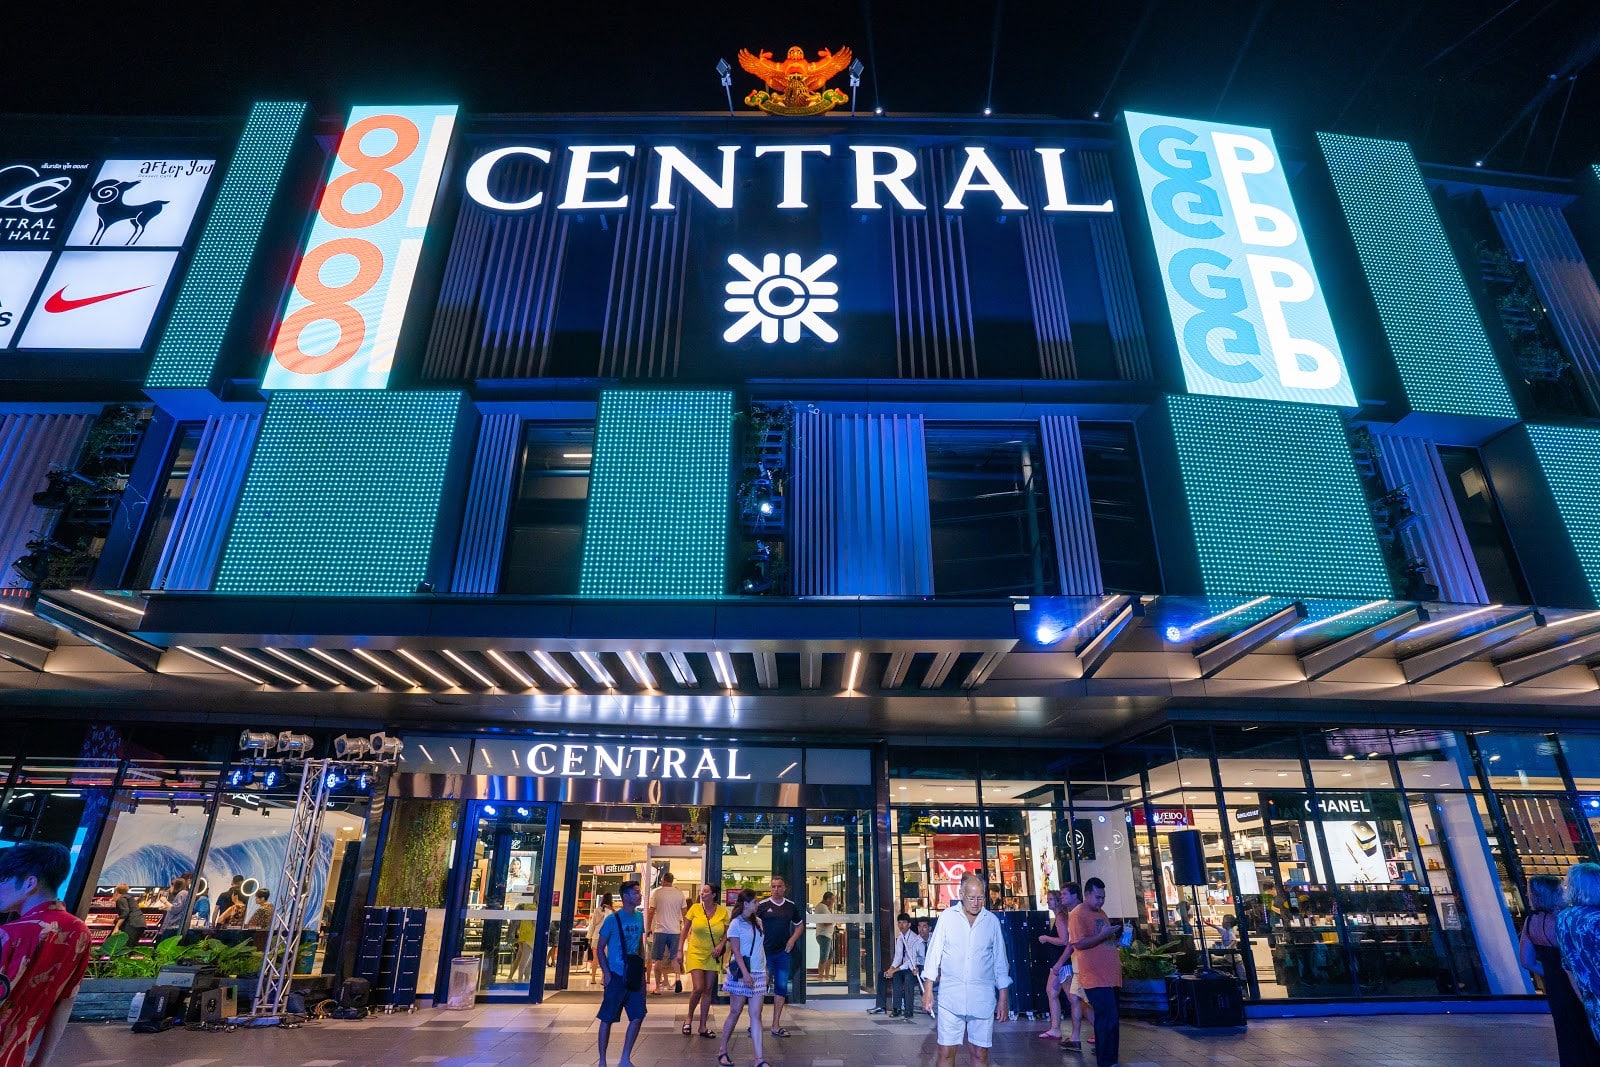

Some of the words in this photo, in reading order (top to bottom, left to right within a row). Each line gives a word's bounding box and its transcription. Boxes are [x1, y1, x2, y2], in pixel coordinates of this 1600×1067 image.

[465, 143, 1114, 214] CENTRAL
[0, 218, 56, 229] TRAL
[8, 231, 51, 241] HALL
[527, 743, 751, 780] CENTRAL
